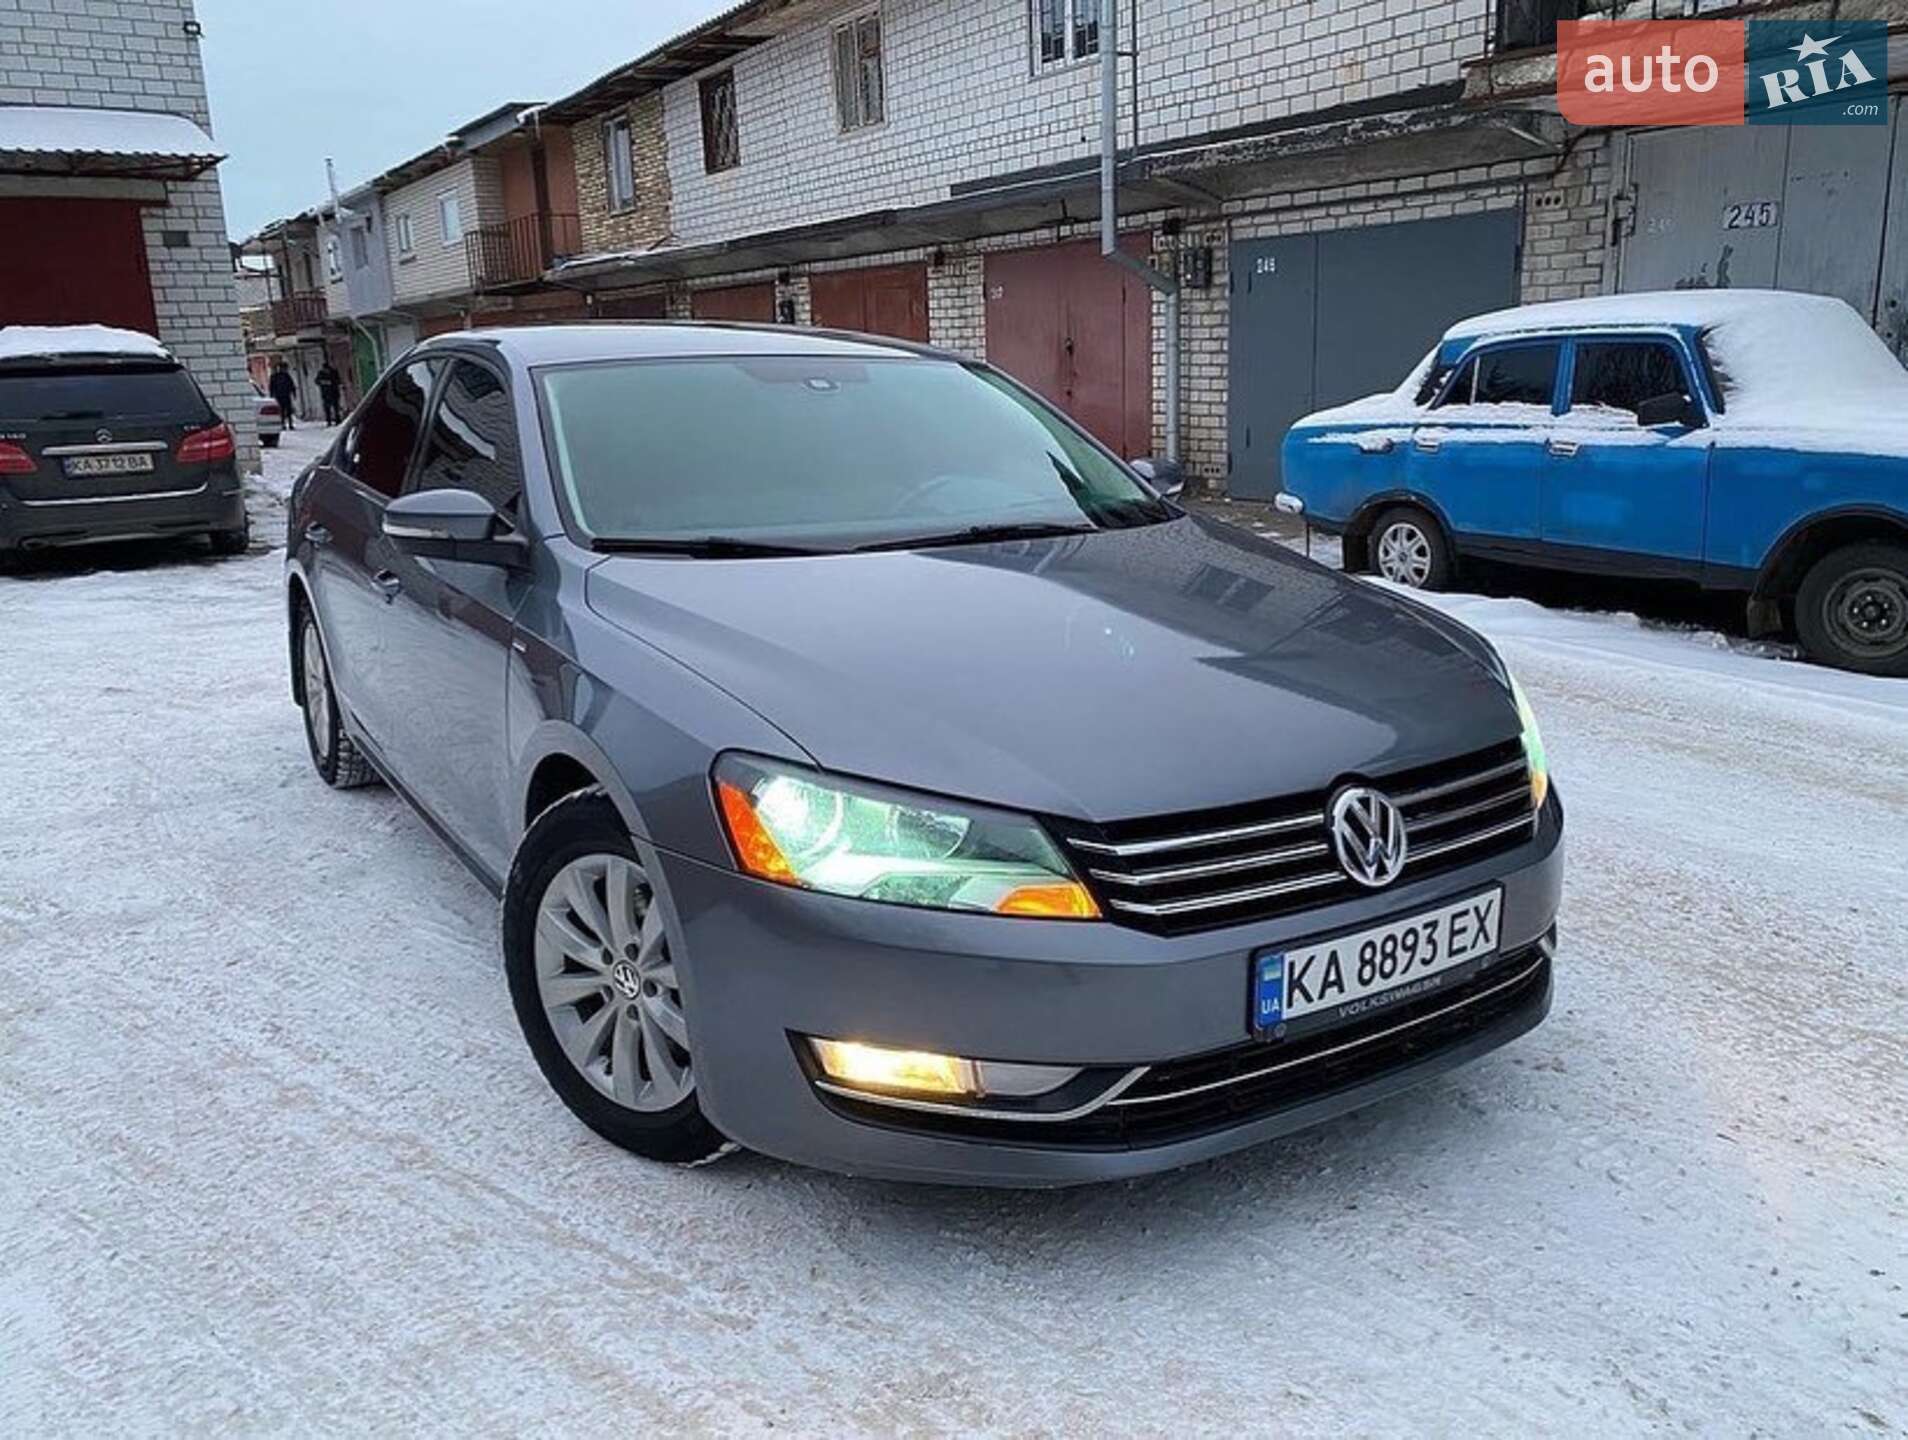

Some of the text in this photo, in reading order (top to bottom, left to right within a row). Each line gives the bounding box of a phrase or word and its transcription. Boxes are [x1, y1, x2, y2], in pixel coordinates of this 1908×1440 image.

[1728, 202, 1771, 229] 245
[73, 459, 93, 472] KA
[95, 457, 126, 470] 3712
[1286, 899, 1494, 1010] KA 8893 EX
[1261, 997, 1280, 1014] UA
